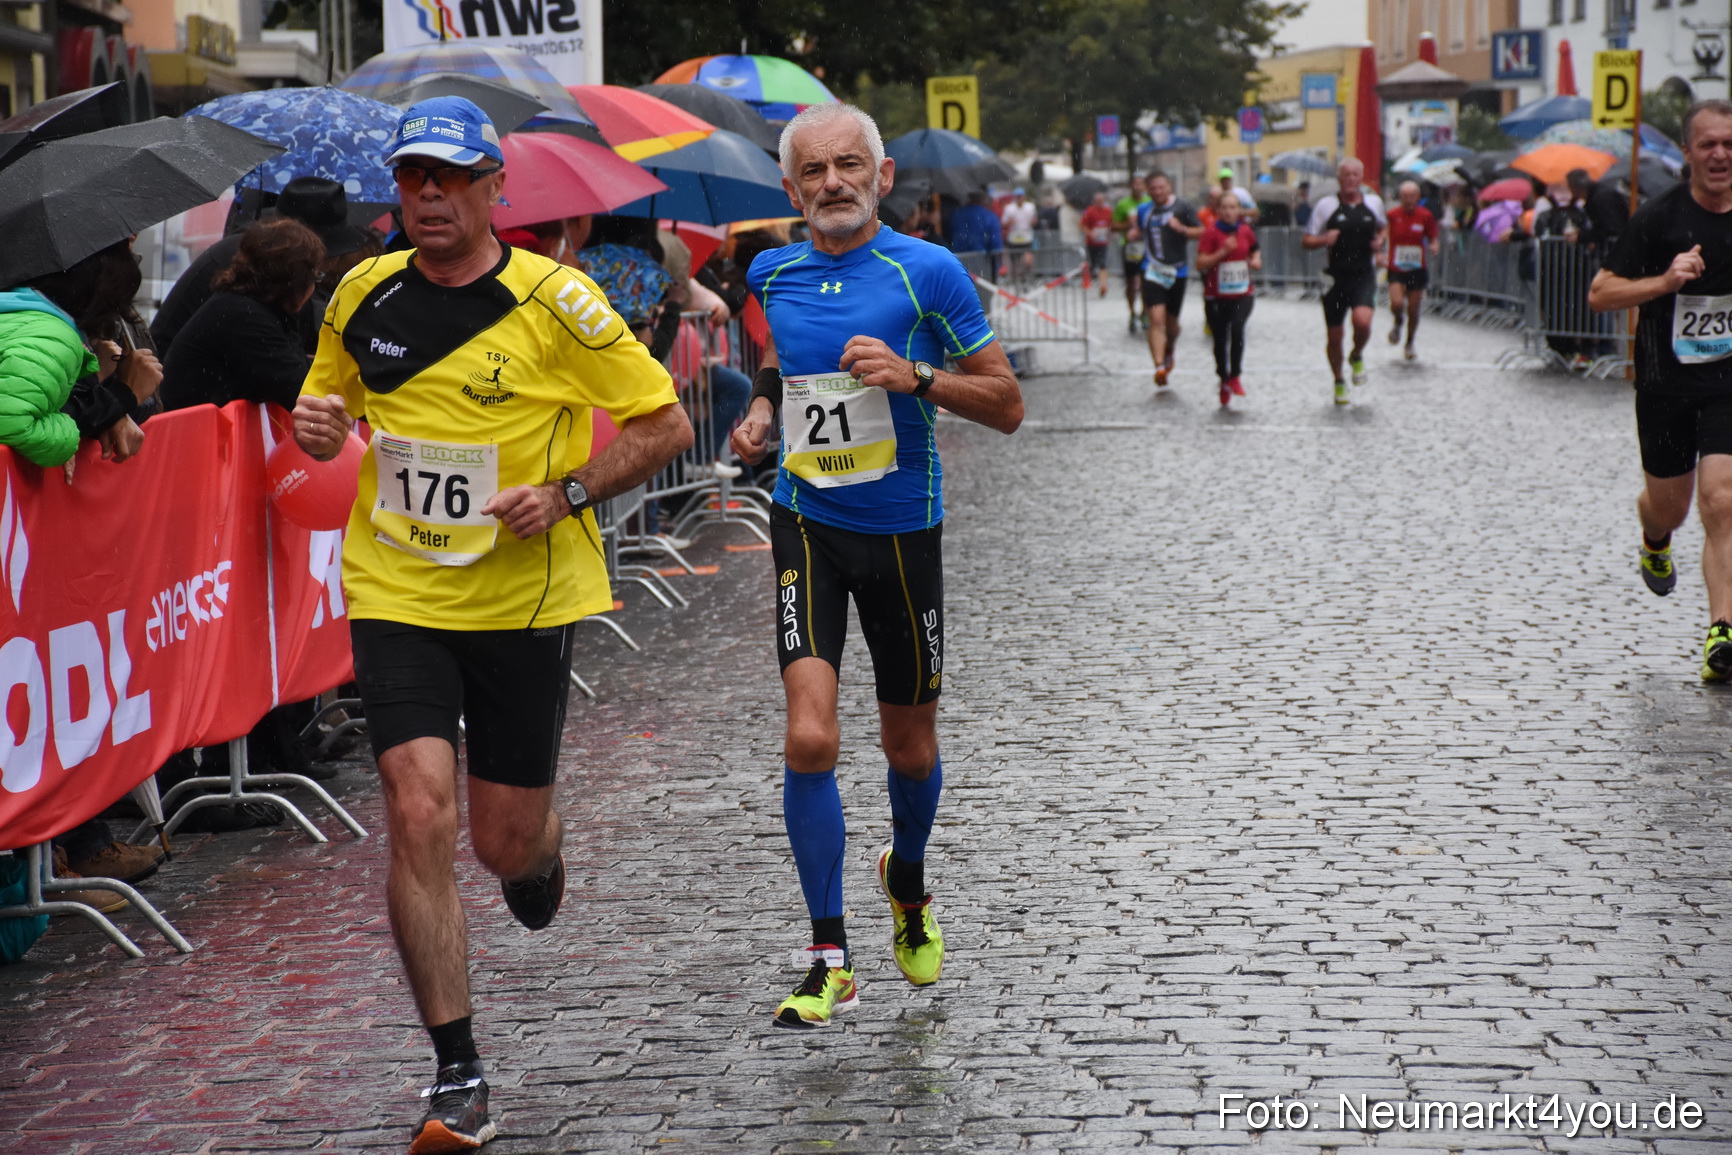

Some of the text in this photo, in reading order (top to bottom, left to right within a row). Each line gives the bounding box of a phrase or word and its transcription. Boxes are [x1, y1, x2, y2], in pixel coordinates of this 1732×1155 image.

[1600, 54, 1639, 68] Block
[1605, 75, 1630, 111] D
[405, 119, 425, 131] BASE
[941, 101, 966, 131] D
[374, 281, 403, 308] STANNO
[370, 338, 407, 358] Peter
[486, 352, 511, 364] TSV
[461, 384, 519, 406] Burgthan
[816, 377, 866, 392] BOC
[805, 401, 851, 445] 21
[421, 444, 485, 463] BOCK
[816, 453, 855, 472] Willi
[396, 468, 470, 519] 176
[410, 525, 450, 547] Peter
[782, 585, 801, 651] SKINS
[923, 609, 941, 674] SKINS
